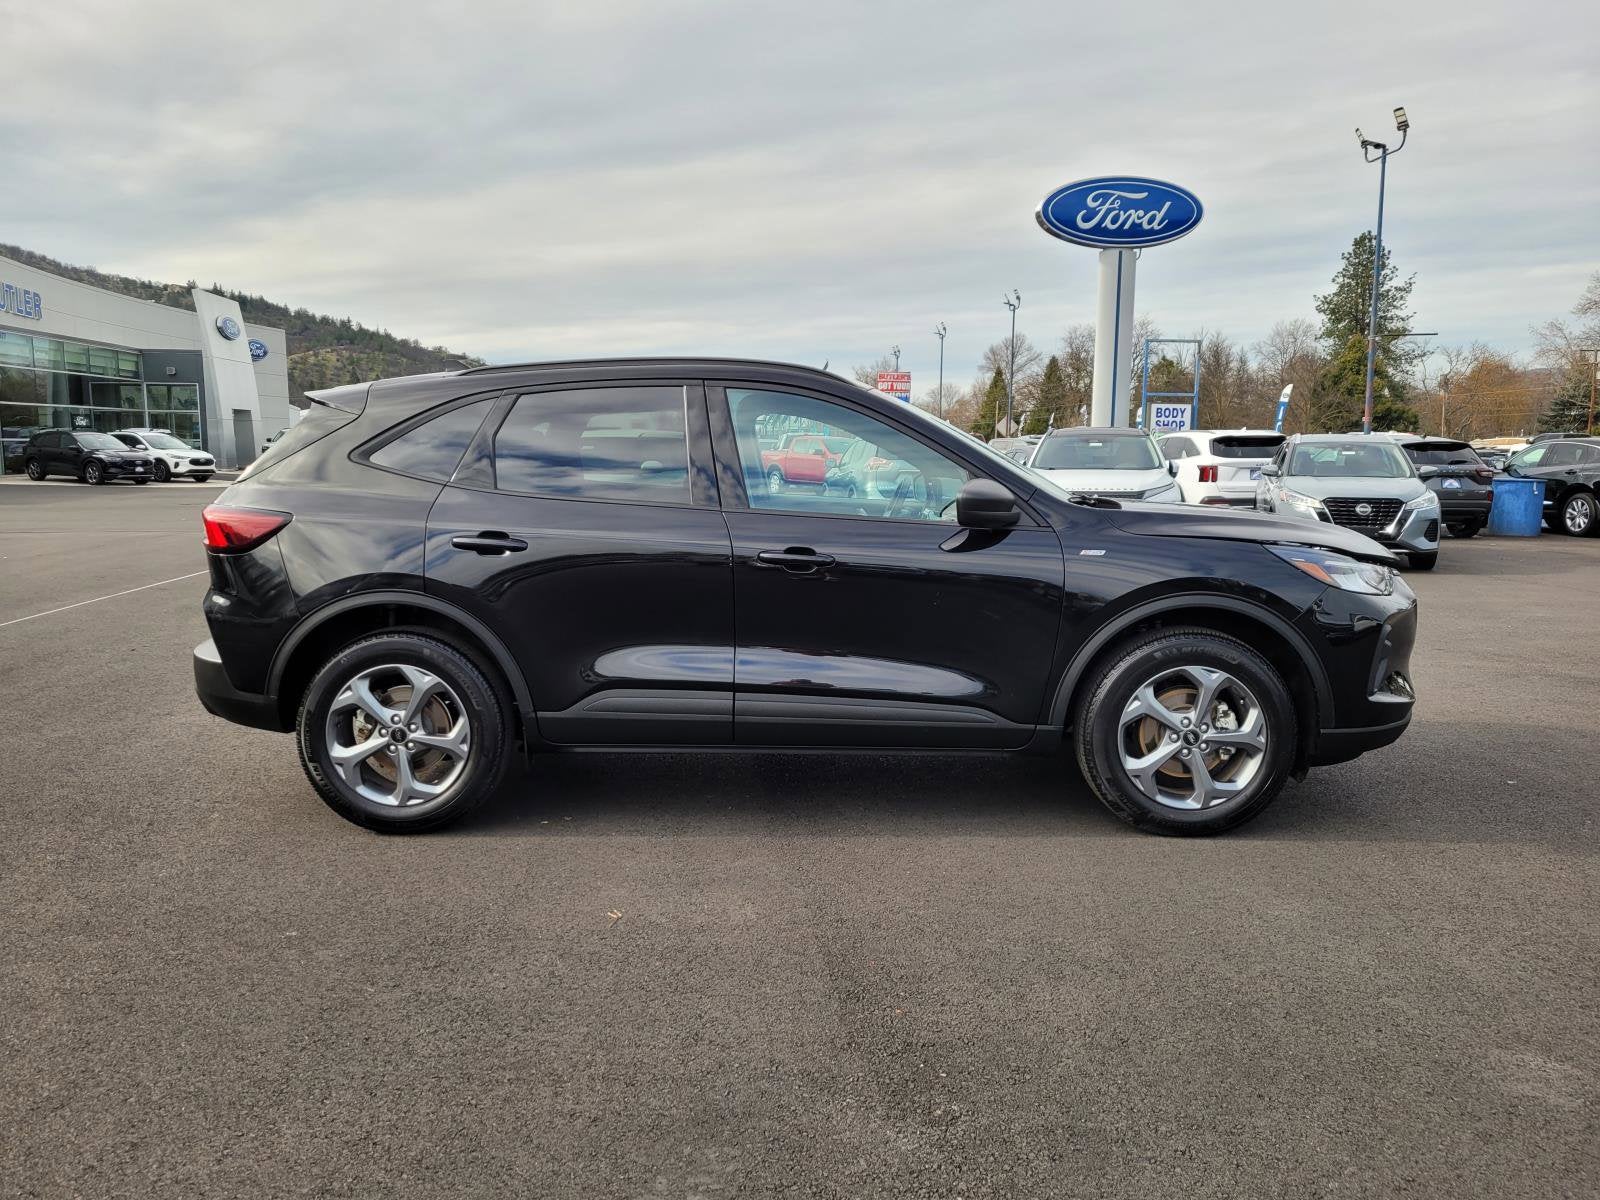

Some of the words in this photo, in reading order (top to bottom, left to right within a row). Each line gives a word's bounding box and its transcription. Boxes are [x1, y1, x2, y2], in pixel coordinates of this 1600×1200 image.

[1076, 189, 1172, 230] Ford
[878, 382, 891, 390] GOT
[892, 382, 911, 390] YOUR
[1155, 407, 1187, 419] BODY
